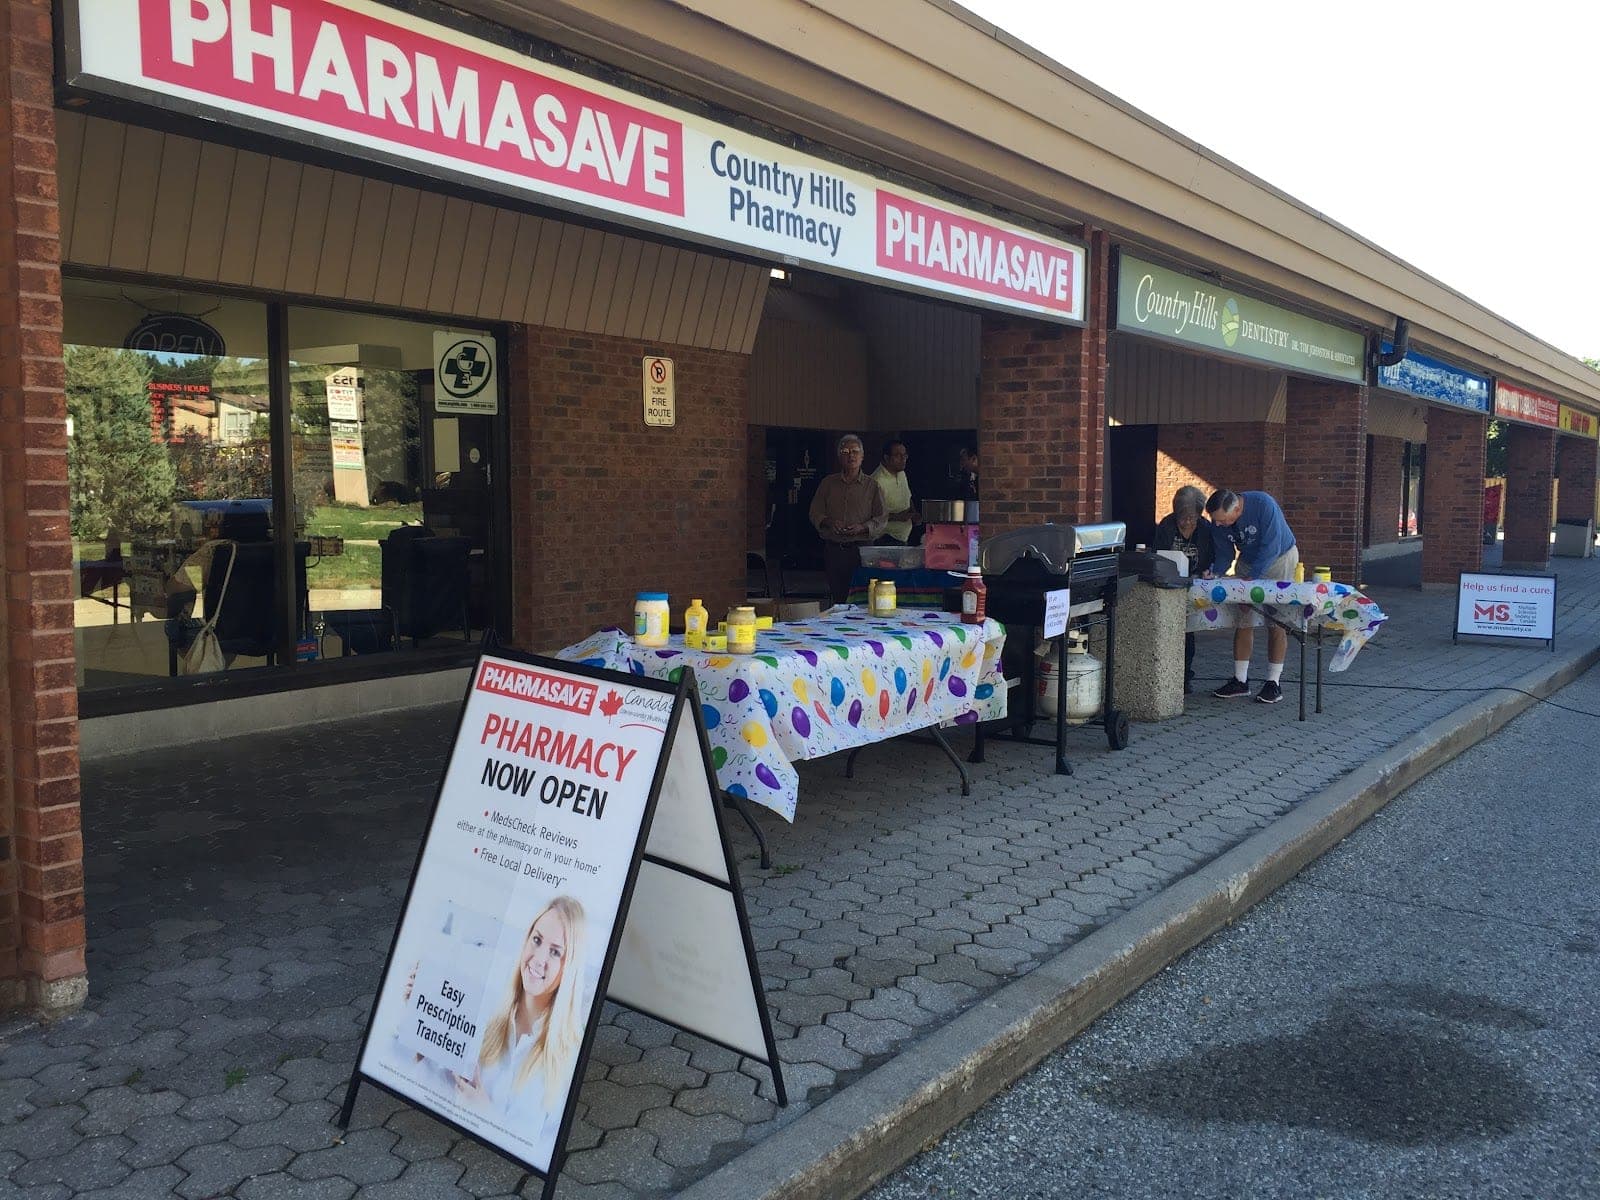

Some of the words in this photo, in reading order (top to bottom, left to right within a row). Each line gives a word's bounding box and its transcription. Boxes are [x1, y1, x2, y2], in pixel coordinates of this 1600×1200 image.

[170, 0, 670, 198] PHARMASAVE
[710, 140, 803, 209] Country
[810, 172, 857, 217] Hills
[729, 187, 841, 257] Pharmacy
[885, 204, 1068, 302] PHARMASAVE
[1242, 320, 1290, 348] DENTISTRY
[148, 382, 182, 392] BUSINESS
[183, 384, 210, 393] HOURS
[652, 397, 667, 407] FIRE
[648, 408, 672, 418] ROUTE
[1463, 582, 1484, 592] Help
[1487, 584, 1497, 592] us
[1500, 583, 1518, 593] find
[1474, 602, 1510, 622] MS
[481, 666, 593, 711] PHARMASAVE
[480, 712, 637, 783] PHARMACY
[481, 758, 536, 798] NOW
[539, 775, 608, 821] OPEN
[457, 819, 477, 834] either
[477, 827, 485, 837] at
[486, 828, 498, 840] the
[499, 834, 532, 856] pharmacy
[533, 846, 543, 856] or
[544, 846, 552, 859] in
[554, 852, 572, 868] your
[490, 810, 537, 836] MedsCheck
[539, 826, 579, 849] Reviews
[480, 847, 498, 864] Free
[499, 853, 521, 873] Local
[440, 980, 465, 1008] Easy
[416, 994, 477, 1038] Prescription
[416, 1018, 467, 1059] Transfers!
